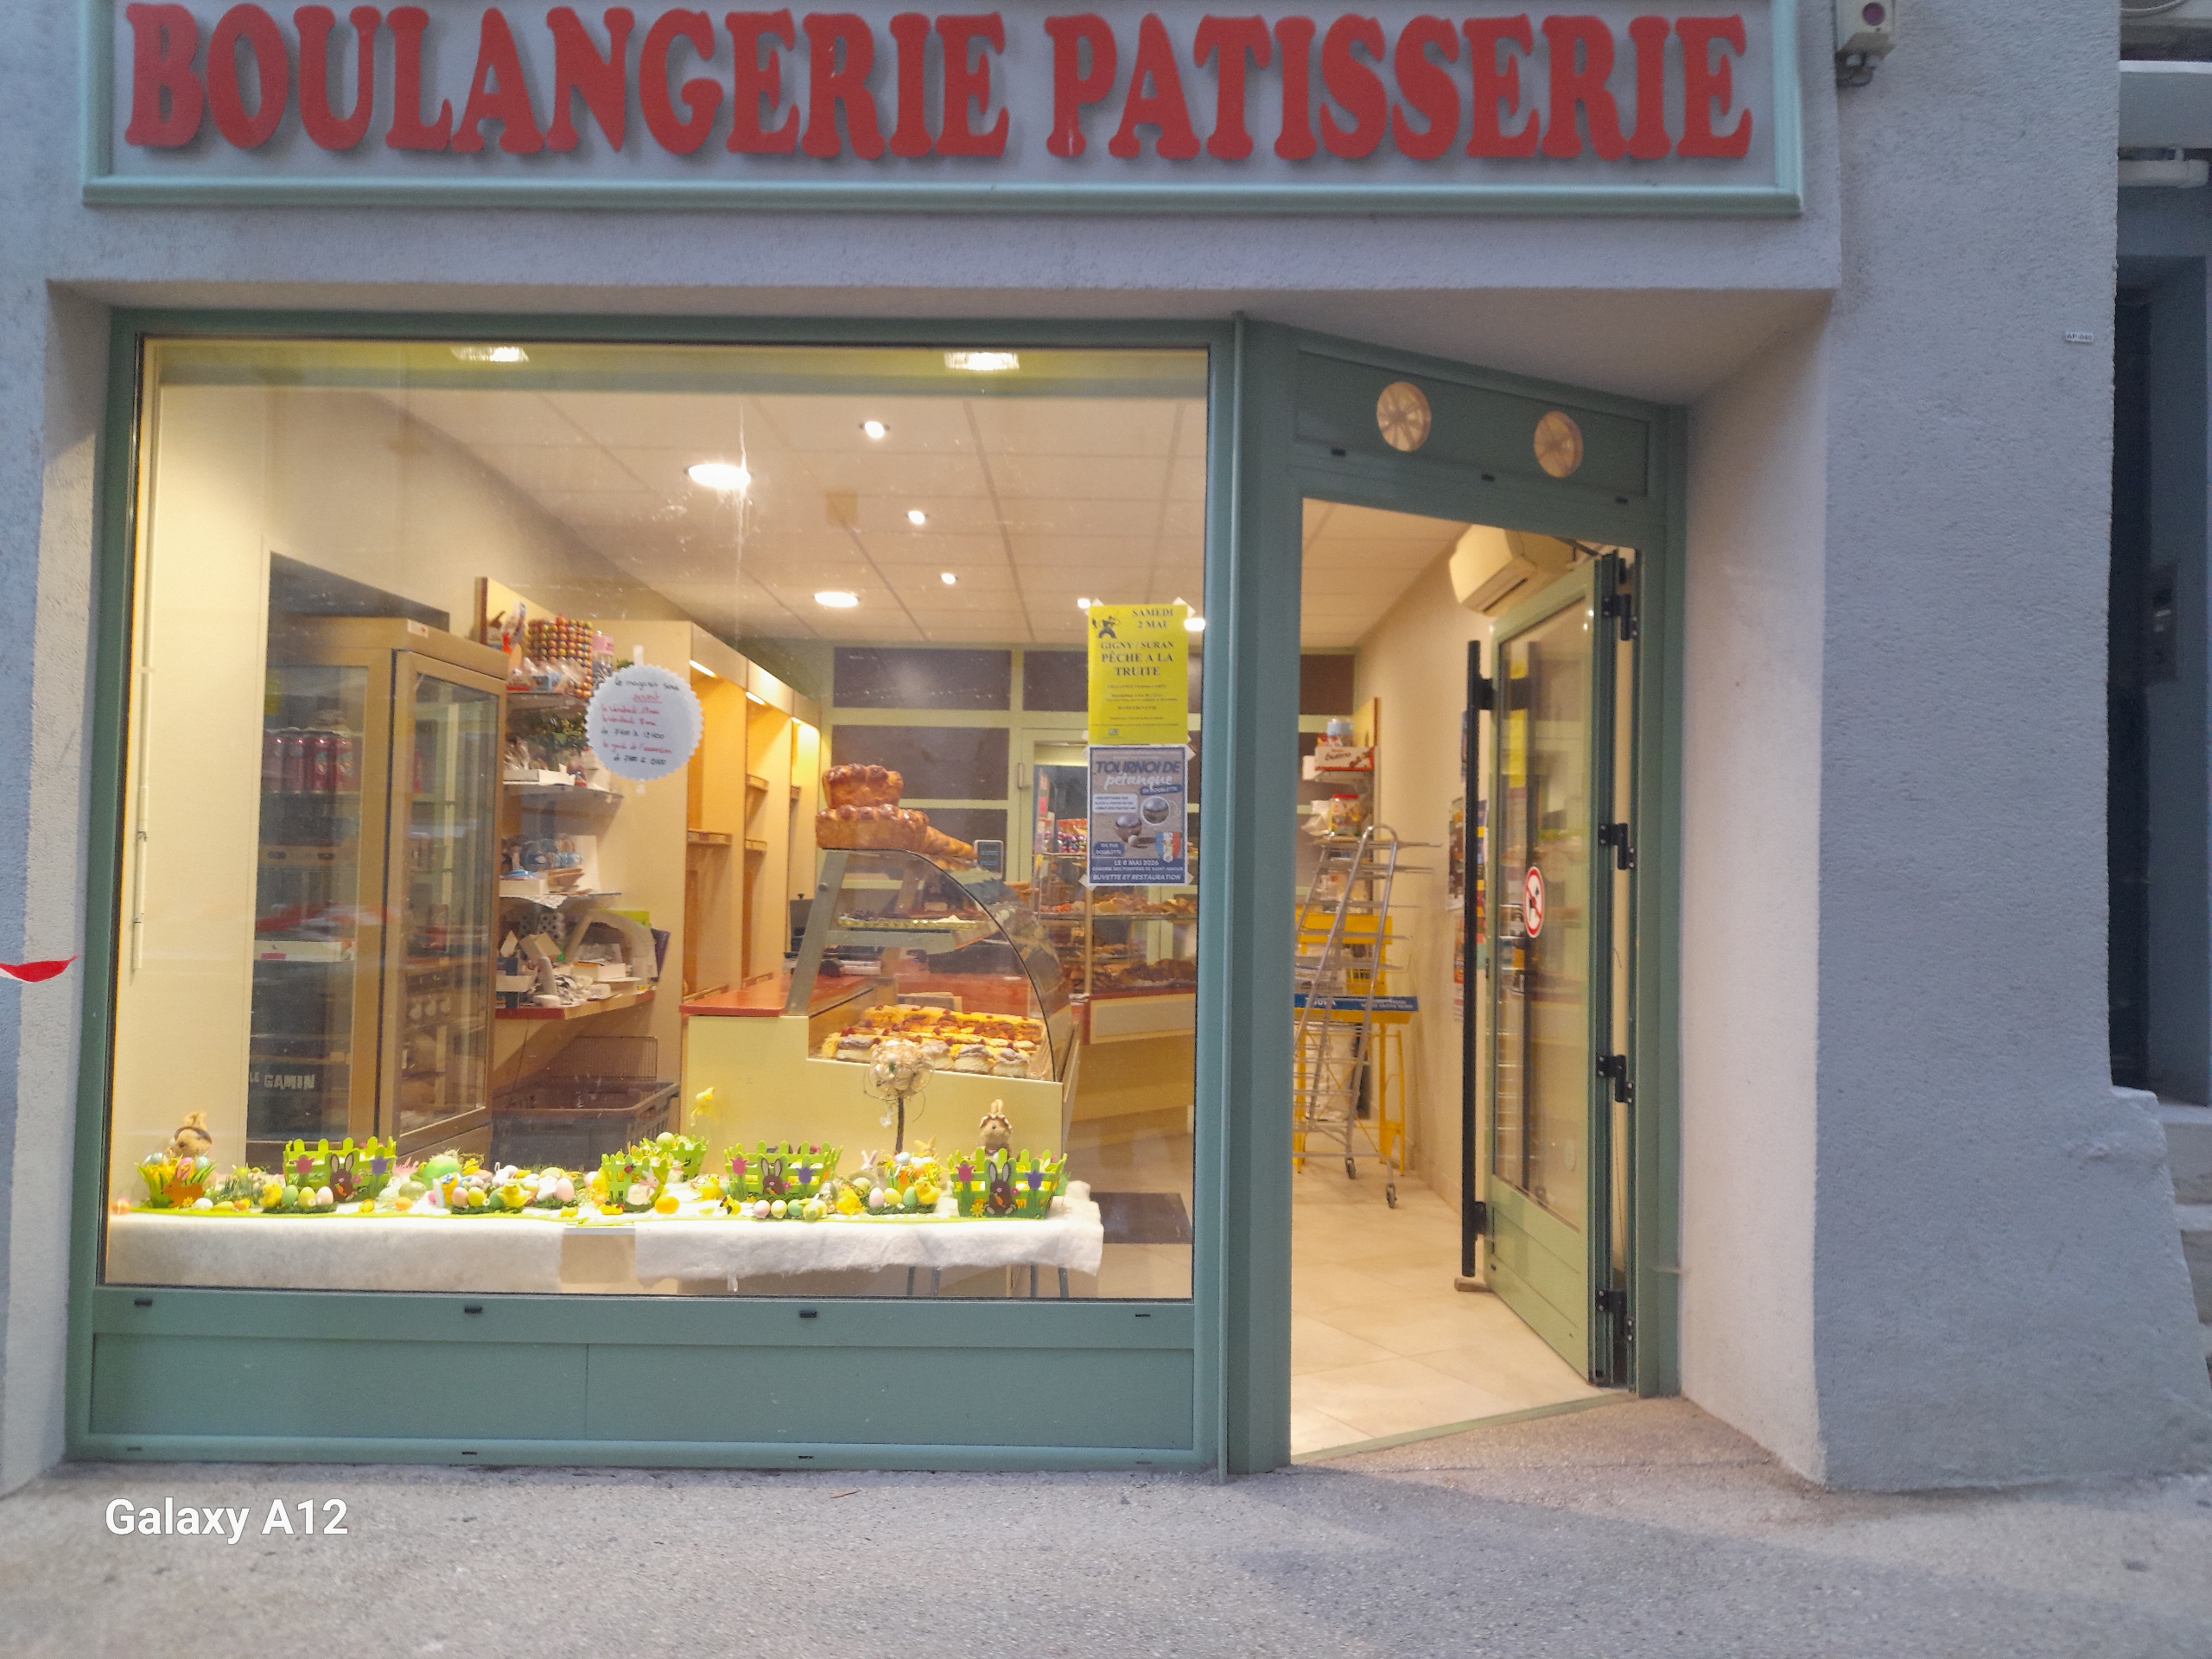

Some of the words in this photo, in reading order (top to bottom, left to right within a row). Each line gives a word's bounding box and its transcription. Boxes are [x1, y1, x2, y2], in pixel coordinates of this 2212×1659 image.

[124, 3, 1009, 159] BOULANGERIE
[1044, 13, 1752, 161] PATISSERIE
[1132, 608, 1173, 617] SAMEDI
[1138, 620, 1142, 629] 2
[1146, 620, 1167, 629] MAI
[1141, 640, 1174, 649] SURAN
[1102, 650, 1142, 663] PÊCHE
[1146, 653, 1154, 663] A
[1158, 653, 1173, 663] LA
[1116, 666, 1160, 677] TRUITE
[1096, 760, 1161, 773] TOURNOI
[1162, 760, 1182, 773] DE
